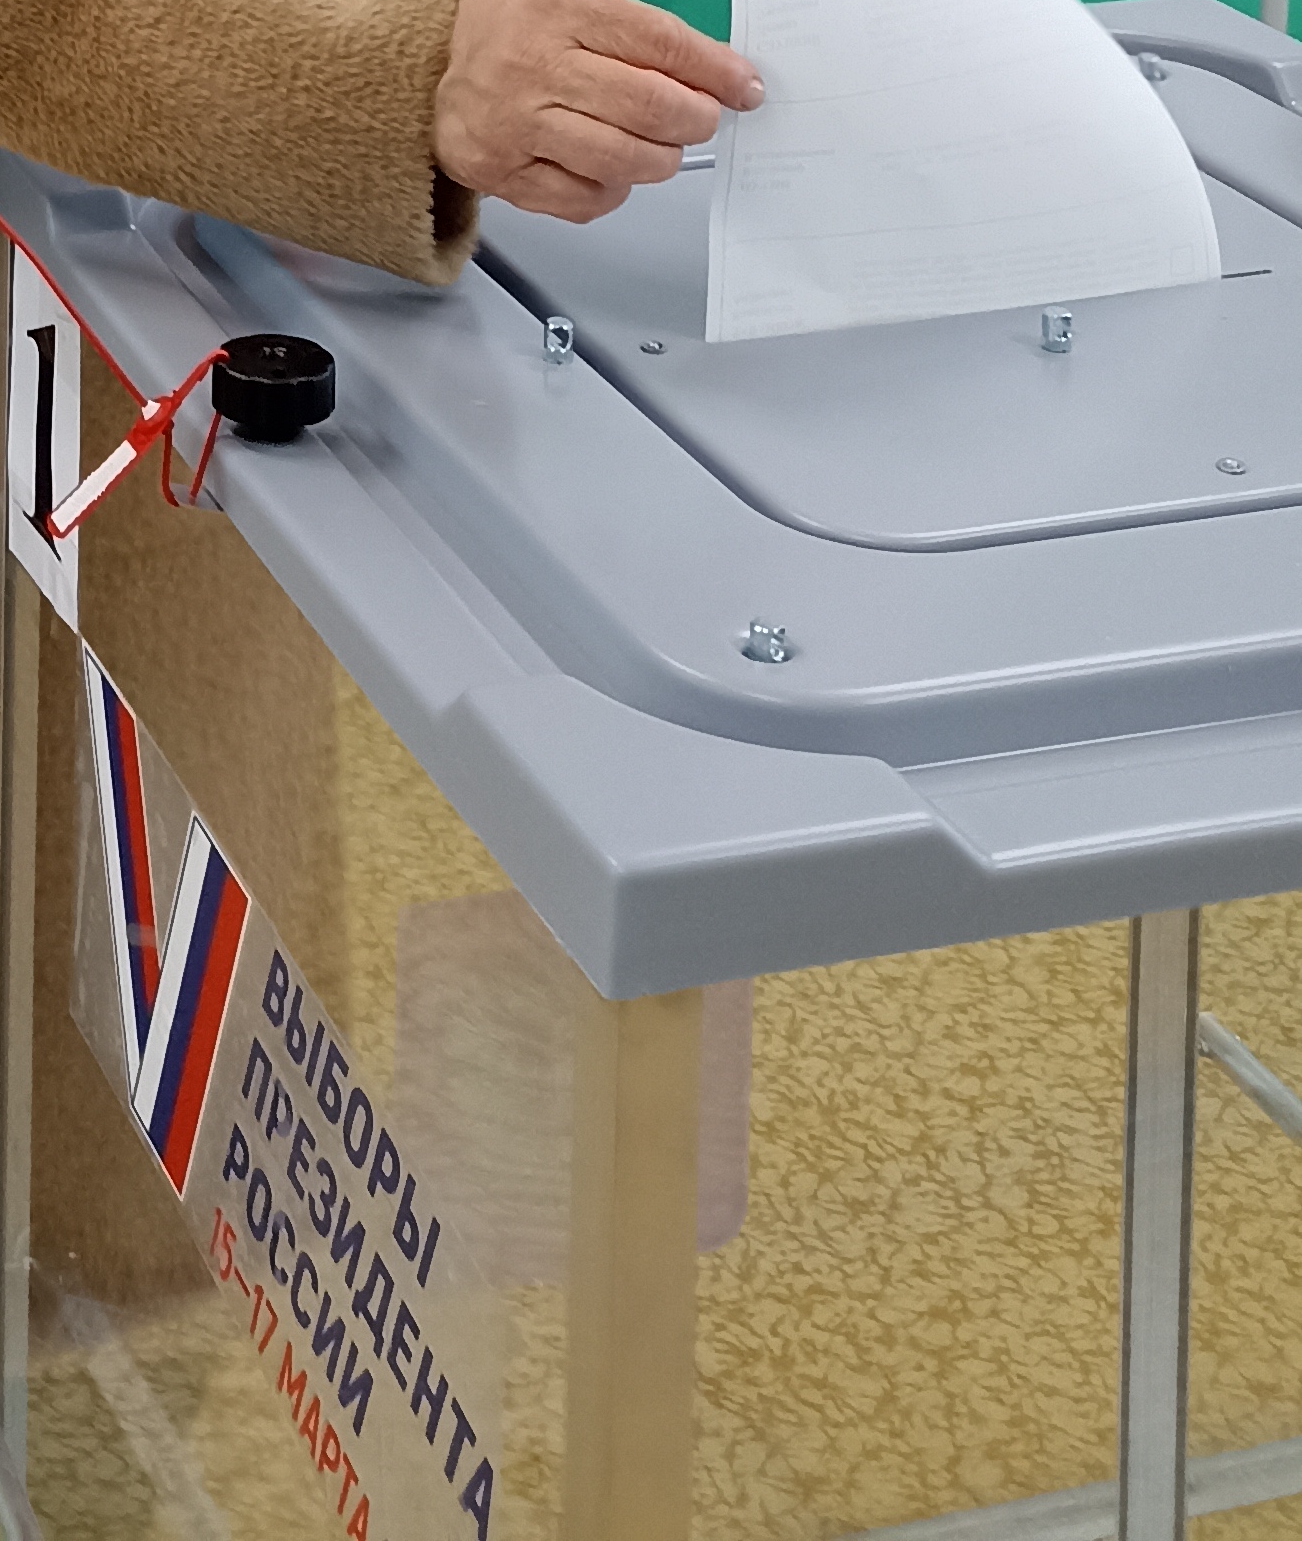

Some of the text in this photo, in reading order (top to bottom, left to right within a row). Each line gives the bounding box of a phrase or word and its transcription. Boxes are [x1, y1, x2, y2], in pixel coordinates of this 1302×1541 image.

[22, 324, 62, 562] 1
[222, 1122, 374, 1437] РОССИИ
[262, 949, 441, 1288] ВЫБОРЫ
[241, 1036, 494, 1541] ПРЕЗИДЕНТА
